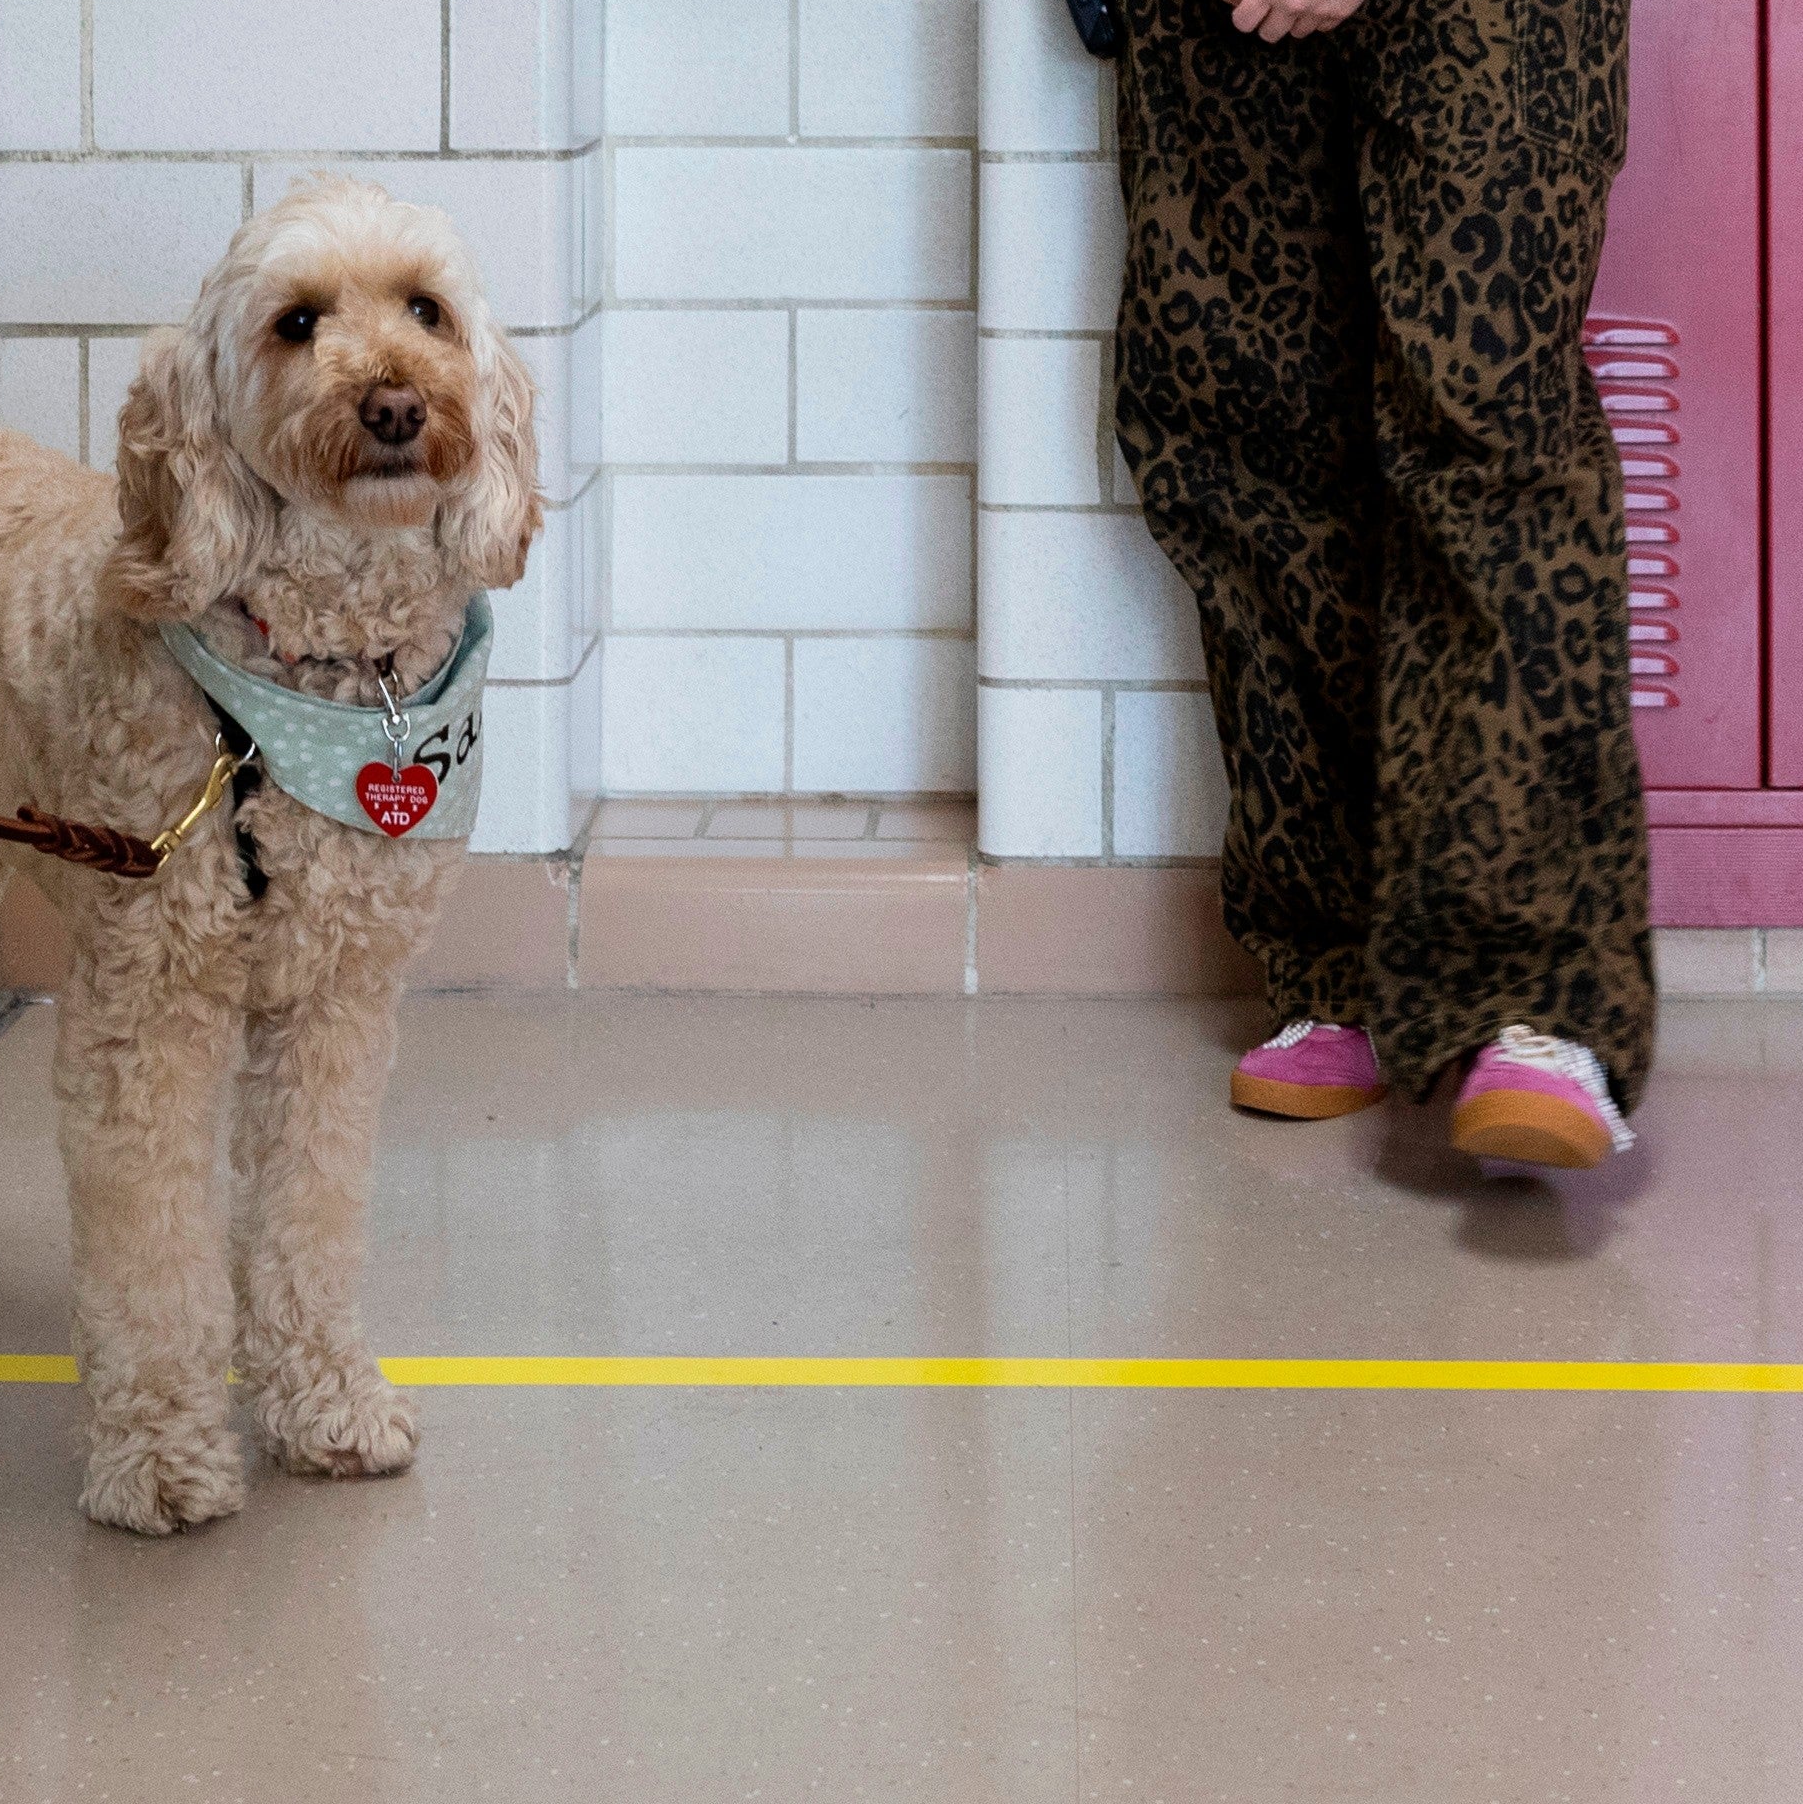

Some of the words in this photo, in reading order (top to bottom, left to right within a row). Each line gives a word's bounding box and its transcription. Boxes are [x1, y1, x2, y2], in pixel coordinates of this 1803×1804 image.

[367, 782, 425, 796] REGISTERED
[365, 792, 406, 803] THERAPY
[409, 795, 428, 805] DOG
[381, 811, 411, 826] ATD
